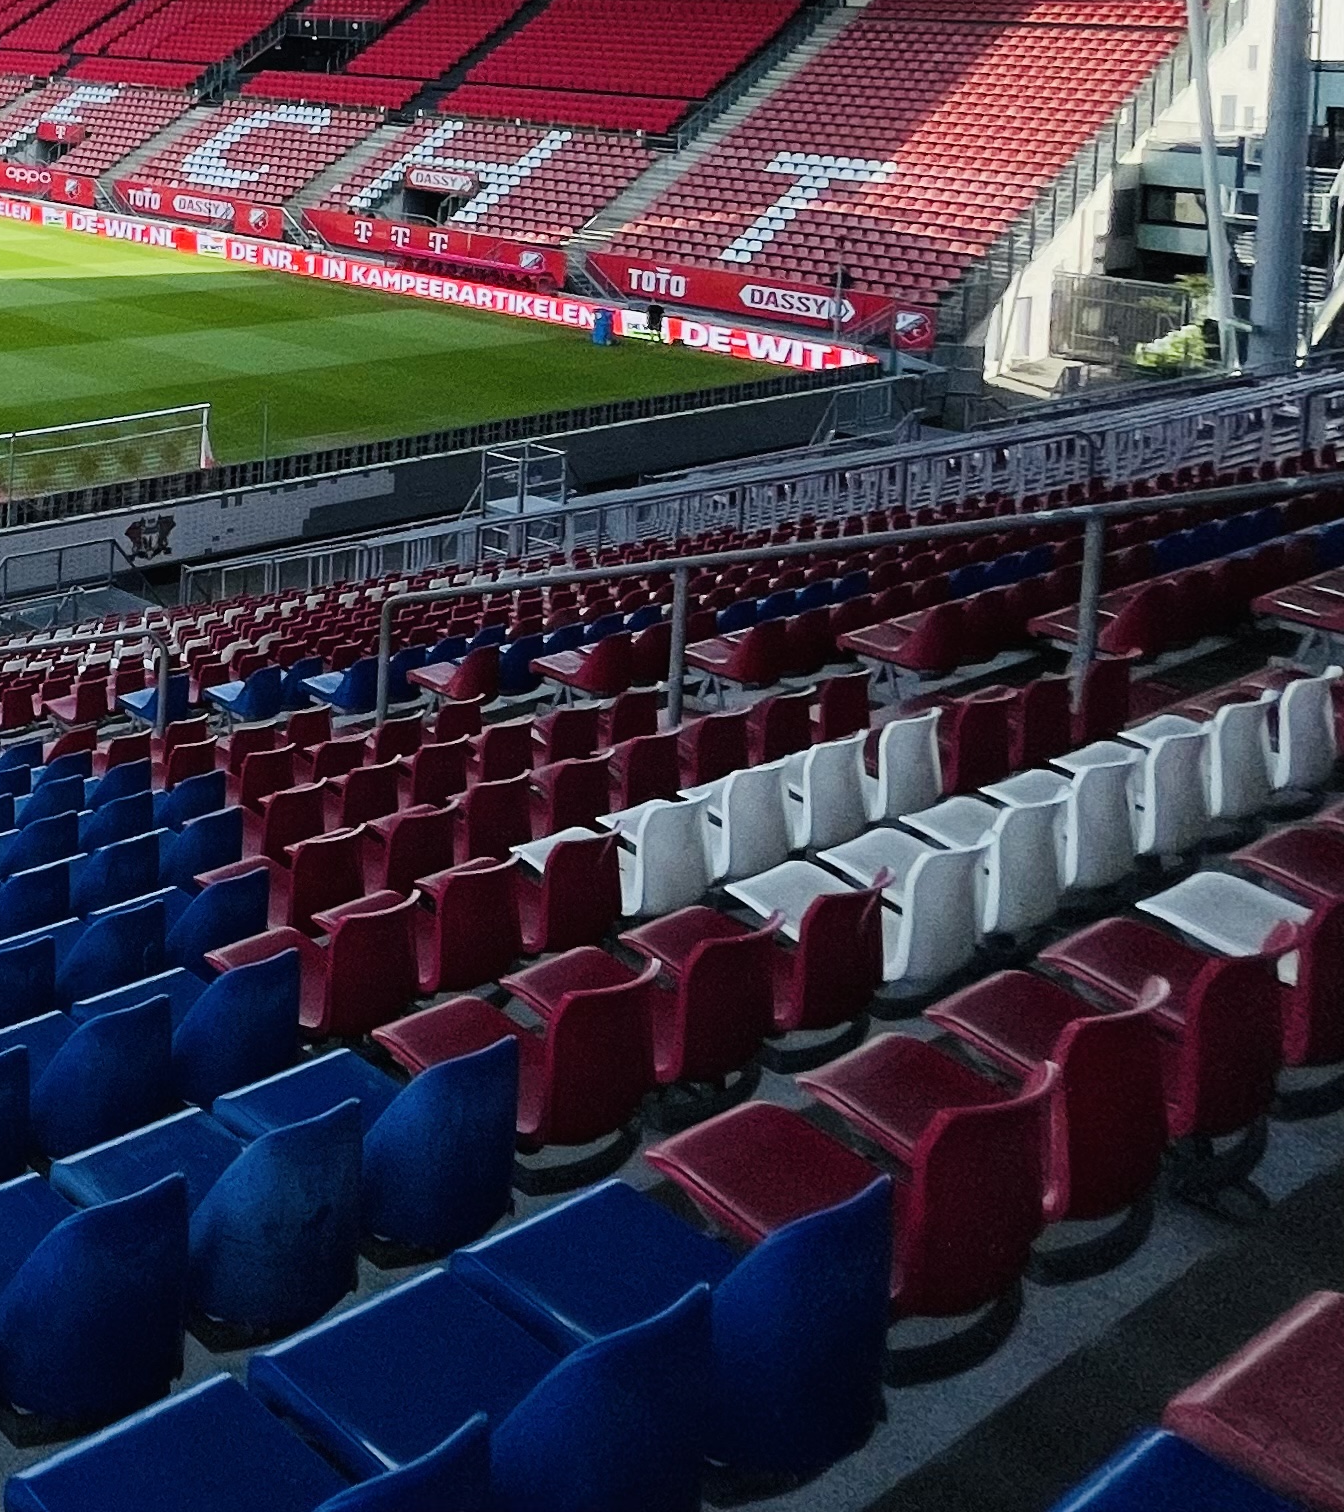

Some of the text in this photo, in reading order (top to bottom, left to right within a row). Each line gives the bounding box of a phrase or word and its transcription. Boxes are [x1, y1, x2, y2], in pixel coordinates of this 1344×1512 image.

[6, 167, 52, 184] oppo
[415, 172, 457, 187] DASSY
[127, 187, 161, 211] TOTO
[73, 212, 177, 248] DE-WIT.NL
[354, 220, 449, 255] T T T
[230, 240, 596, 330] DE NR. 1 IN KAMPEERARTIKELEN
[627, 267, 688, 298] TOTO
[749, 288, 828, 316] DASSY
